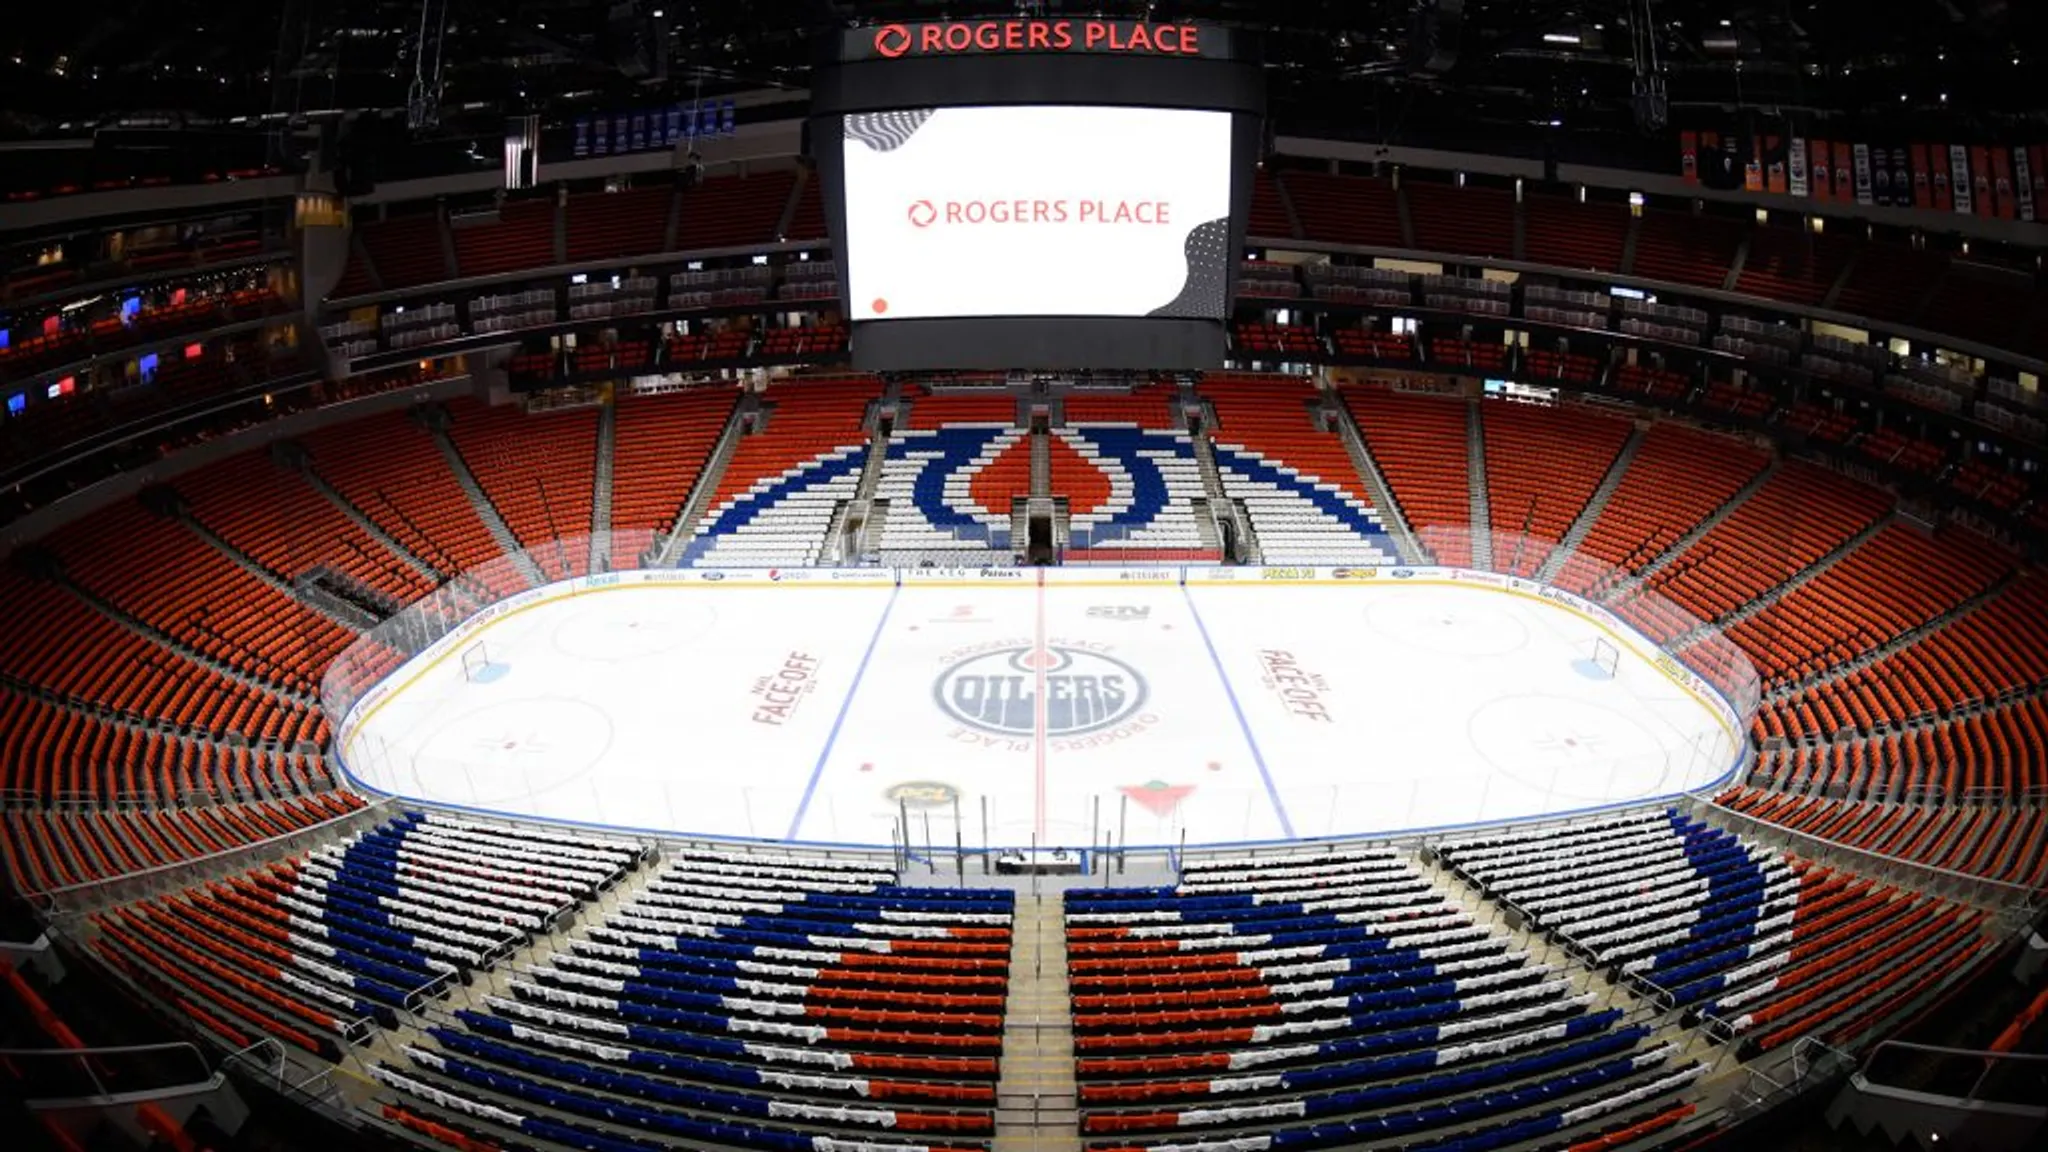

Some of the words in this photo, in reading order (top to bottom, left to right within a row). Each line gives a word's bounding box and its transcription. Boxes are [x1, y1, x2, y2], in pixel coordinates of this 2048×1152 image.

[921, 22, 1073, 51] ROGERS
[1085, 21, 1200, 53] PLACE
[946, 200, 1068, 224] ROGERS
[1079, 199, 1170, 224] PLACE
[752, 650, 817, 725] FACE-OFF
[952, 674, 1126, 731] OILERS
[1260, 649, 1335, 722] FACE-OFF
